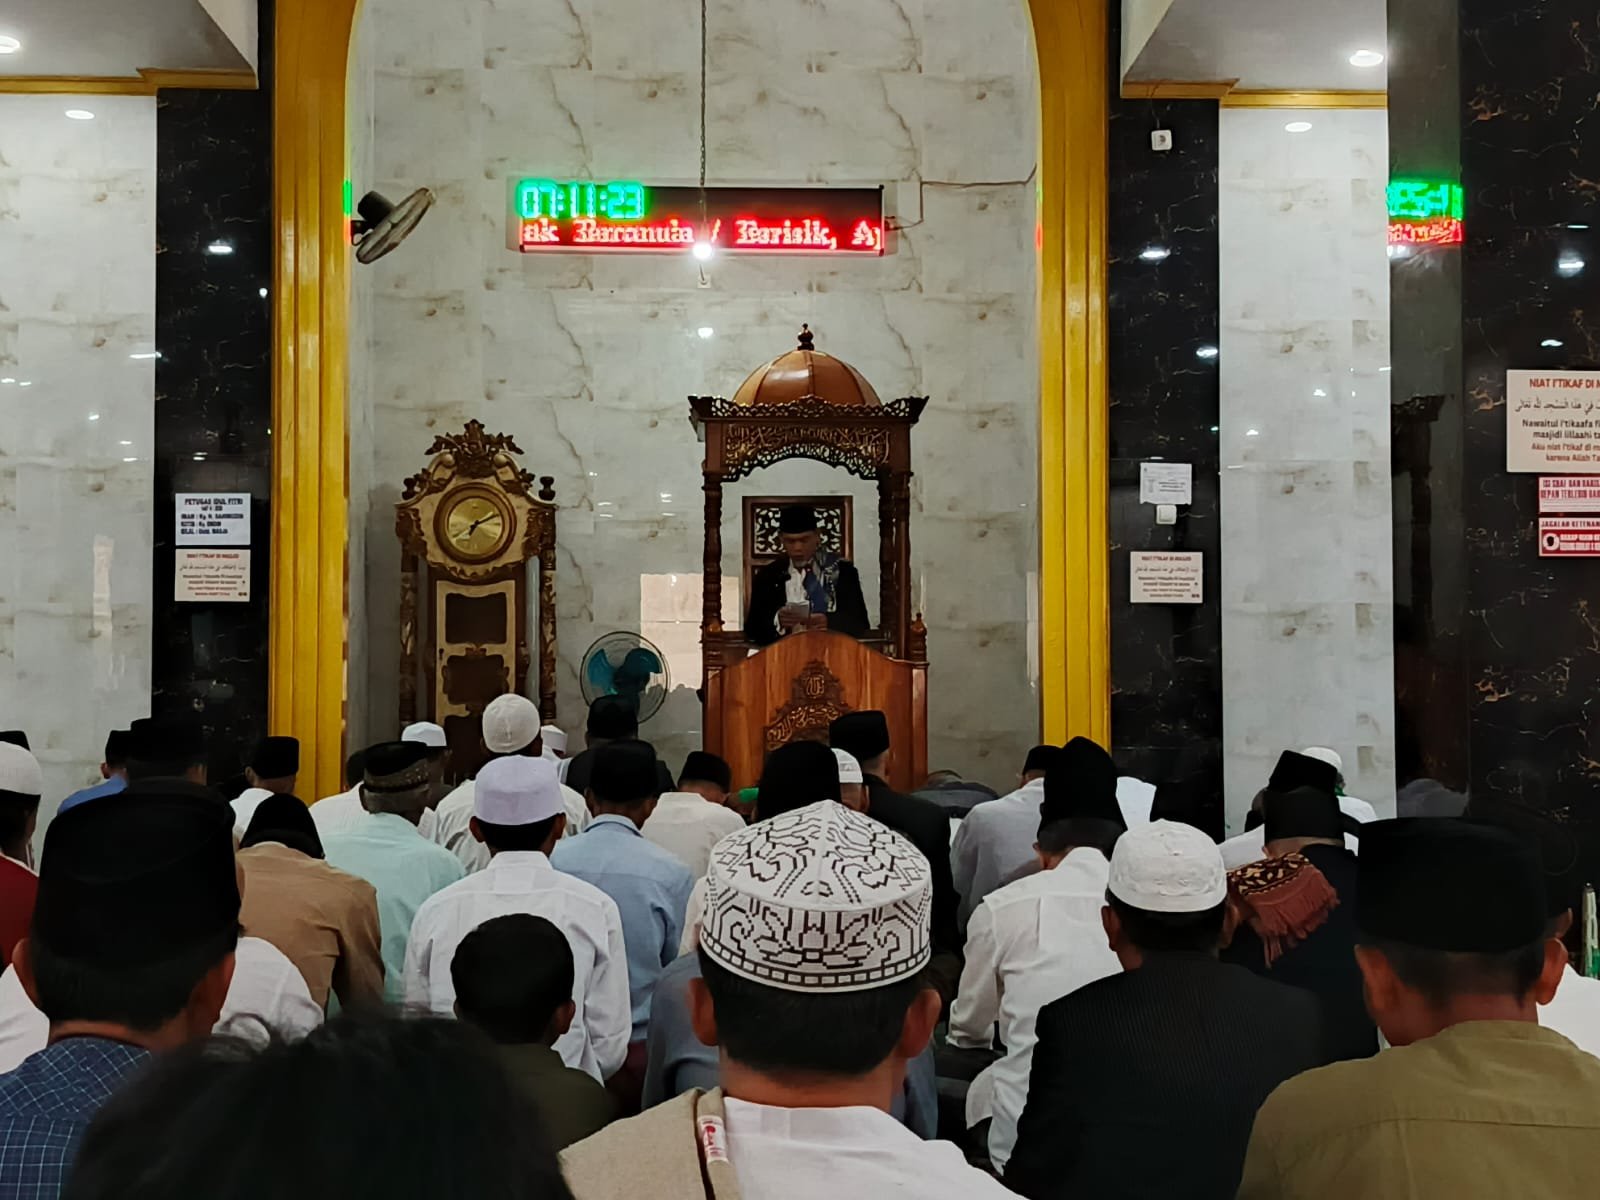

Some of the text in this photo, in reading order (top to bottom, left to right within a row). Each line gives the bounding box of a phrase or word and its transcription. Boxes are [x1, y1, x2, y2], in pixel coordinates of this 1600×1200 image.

[519, 183, 645, 219] 07:11:23
[1529, 378, 1551, 388] NIAT
[1585, 379, 1595, 389] DI
